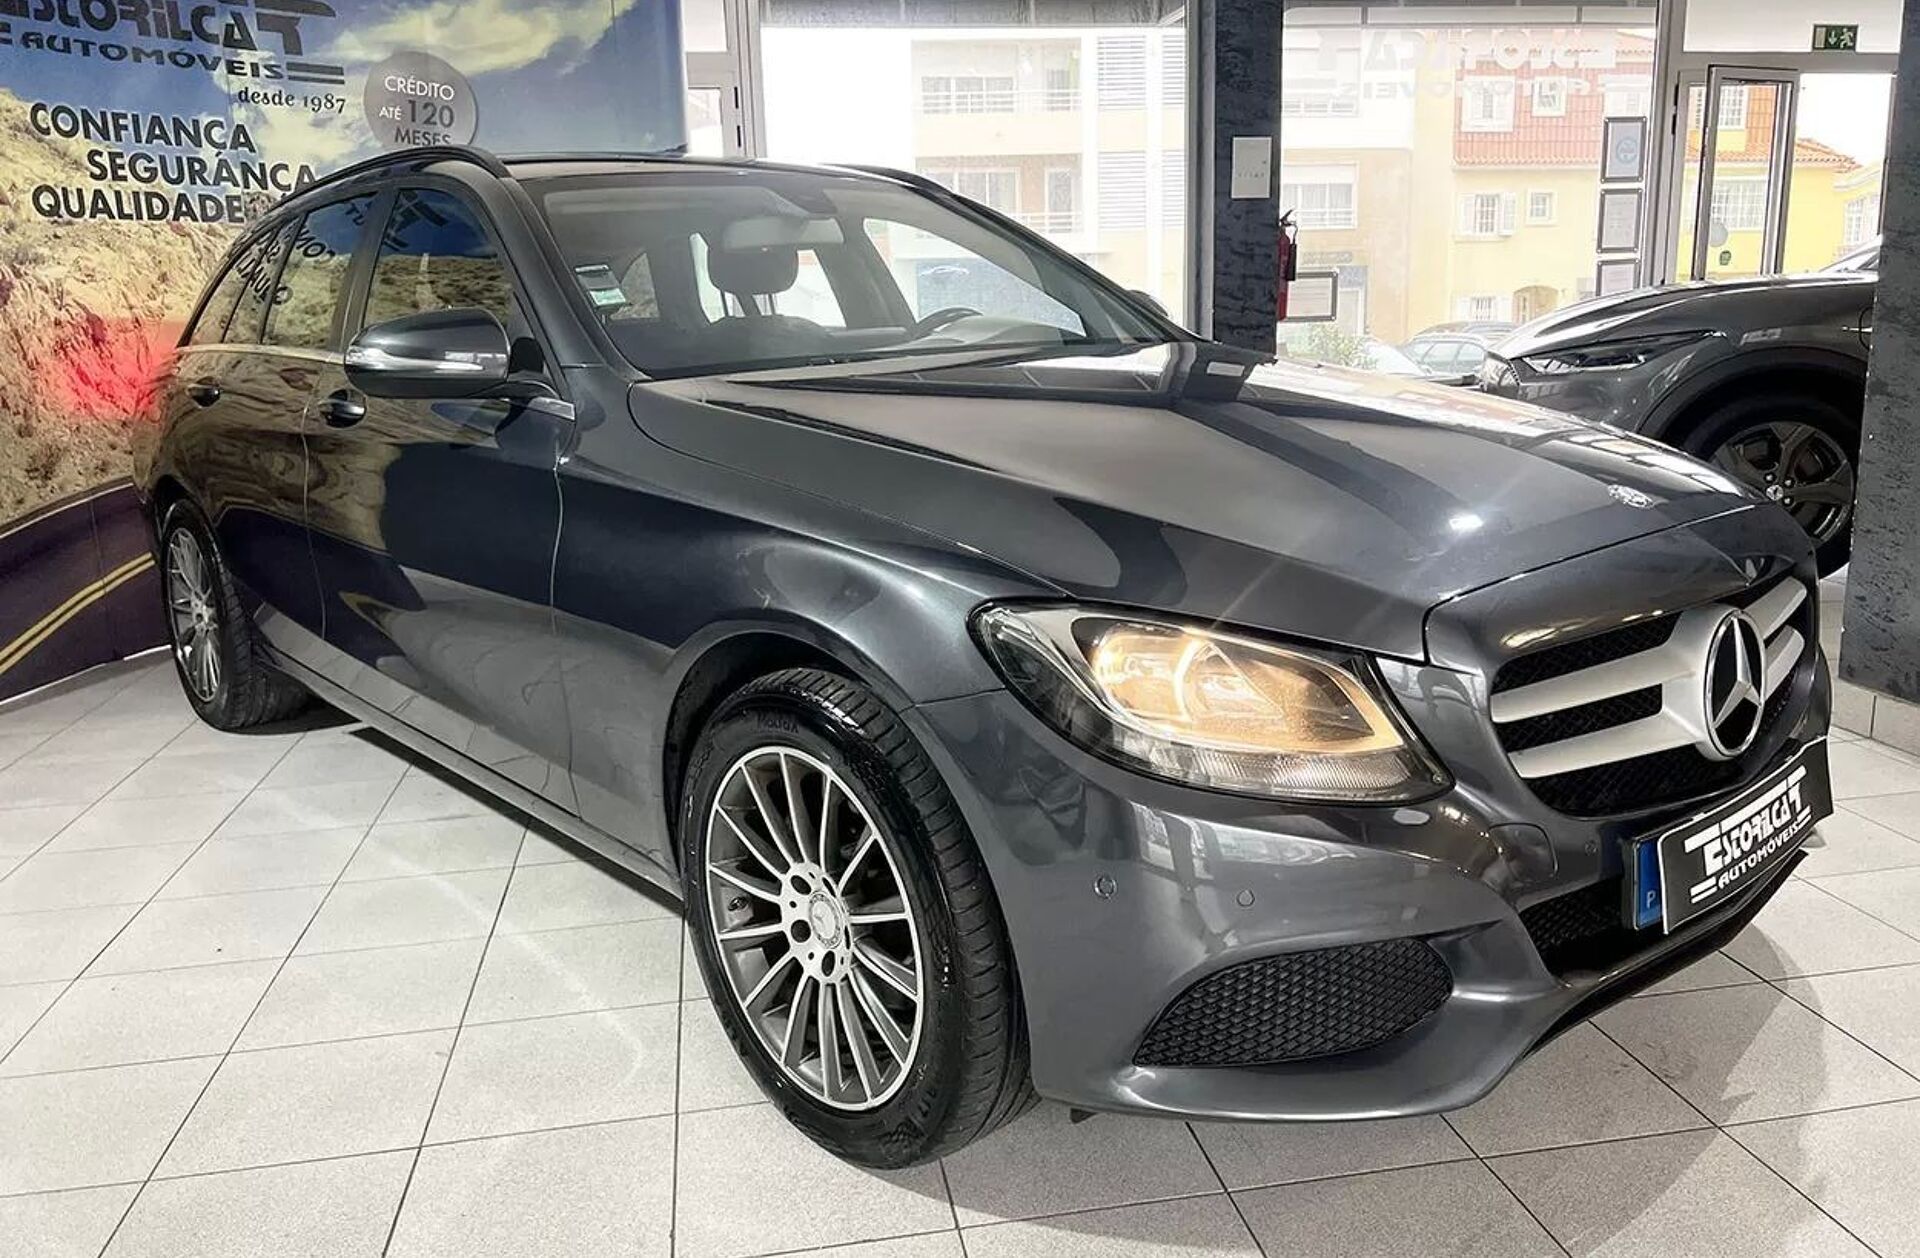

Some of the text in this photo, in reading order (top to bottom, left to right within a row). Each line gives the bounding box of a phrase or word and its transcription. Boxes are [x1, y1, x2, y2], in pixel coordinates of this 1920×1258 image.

[21, 31, 284, 80] AUTOMÓVEIS
[238, 87, 347, 114] desde 1987
[384, 74, 455, 101] CRÉDITO
[29, 102, 256, 157] CONFIANÇA
[379, 99, 455, 128] ATÉ 120
[394, 126, 452, 146] MESES
[31, 184, 245, 223] QUALIDADE
[1699, 768, 1806, 877] ESTORILCAT
[1717, 821, 1800, 889] AUTOMÓVEIS
[1646, 890, 1657, 908] P
